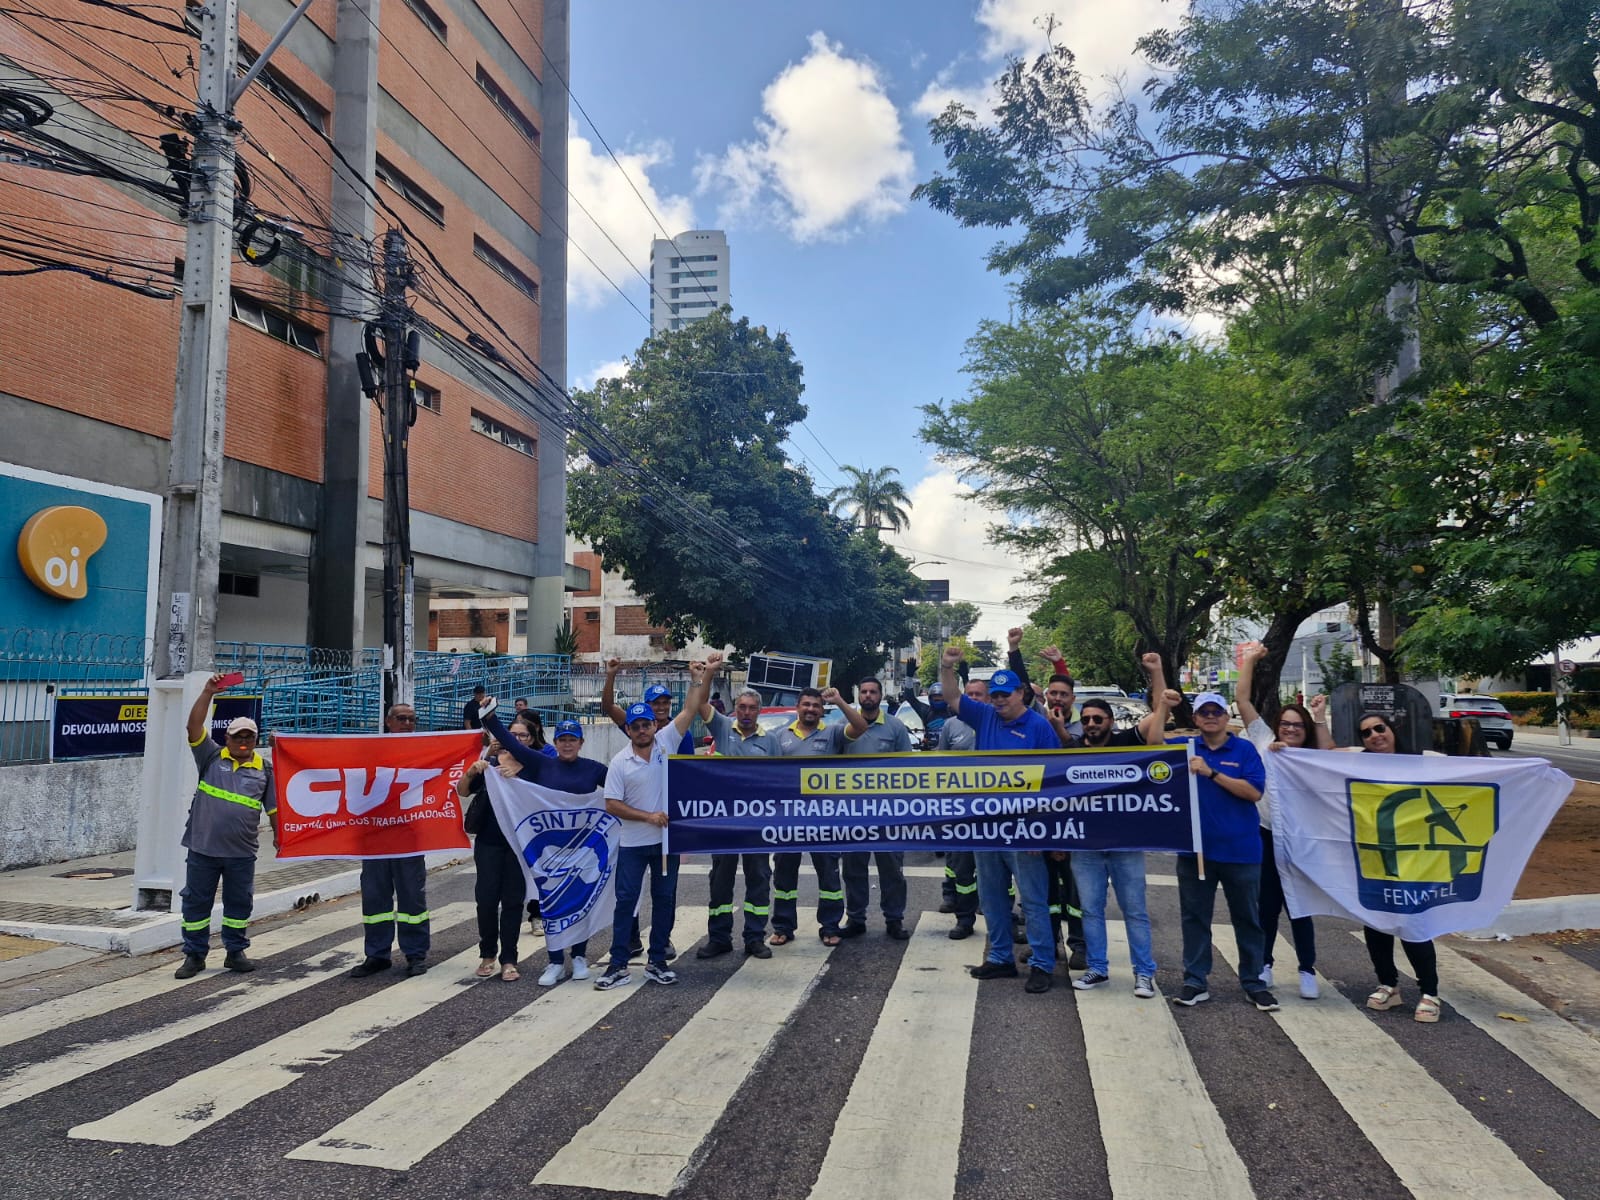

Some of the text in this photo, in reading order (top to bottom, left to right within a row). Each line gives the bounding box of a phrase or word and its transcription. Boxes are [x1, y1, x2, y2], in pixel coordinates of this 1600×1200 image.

[45, 546, 80, 589] oi
[124, 708, 135, 718] OI
[136, 708, 143, 718] E
[61, 723, 119, 736] DEVOLVAM
[807, 770, 1032, 790] OI E SEREDE FALIDAS,
[286, 766, 444, 818] CUT
[678, 793, 1181, 817] VIDA DOS TRABALHADORES COMPROMETIDAS.
[349, 816, 370, 827] DOS
[372, 809, 457, 827] TRABALHADORES
[761, 818, 1085, 844] QUEREMOS UMA SOLUÇÃO JÁ!
[1383, 883, 1458, 906] FENATEL
